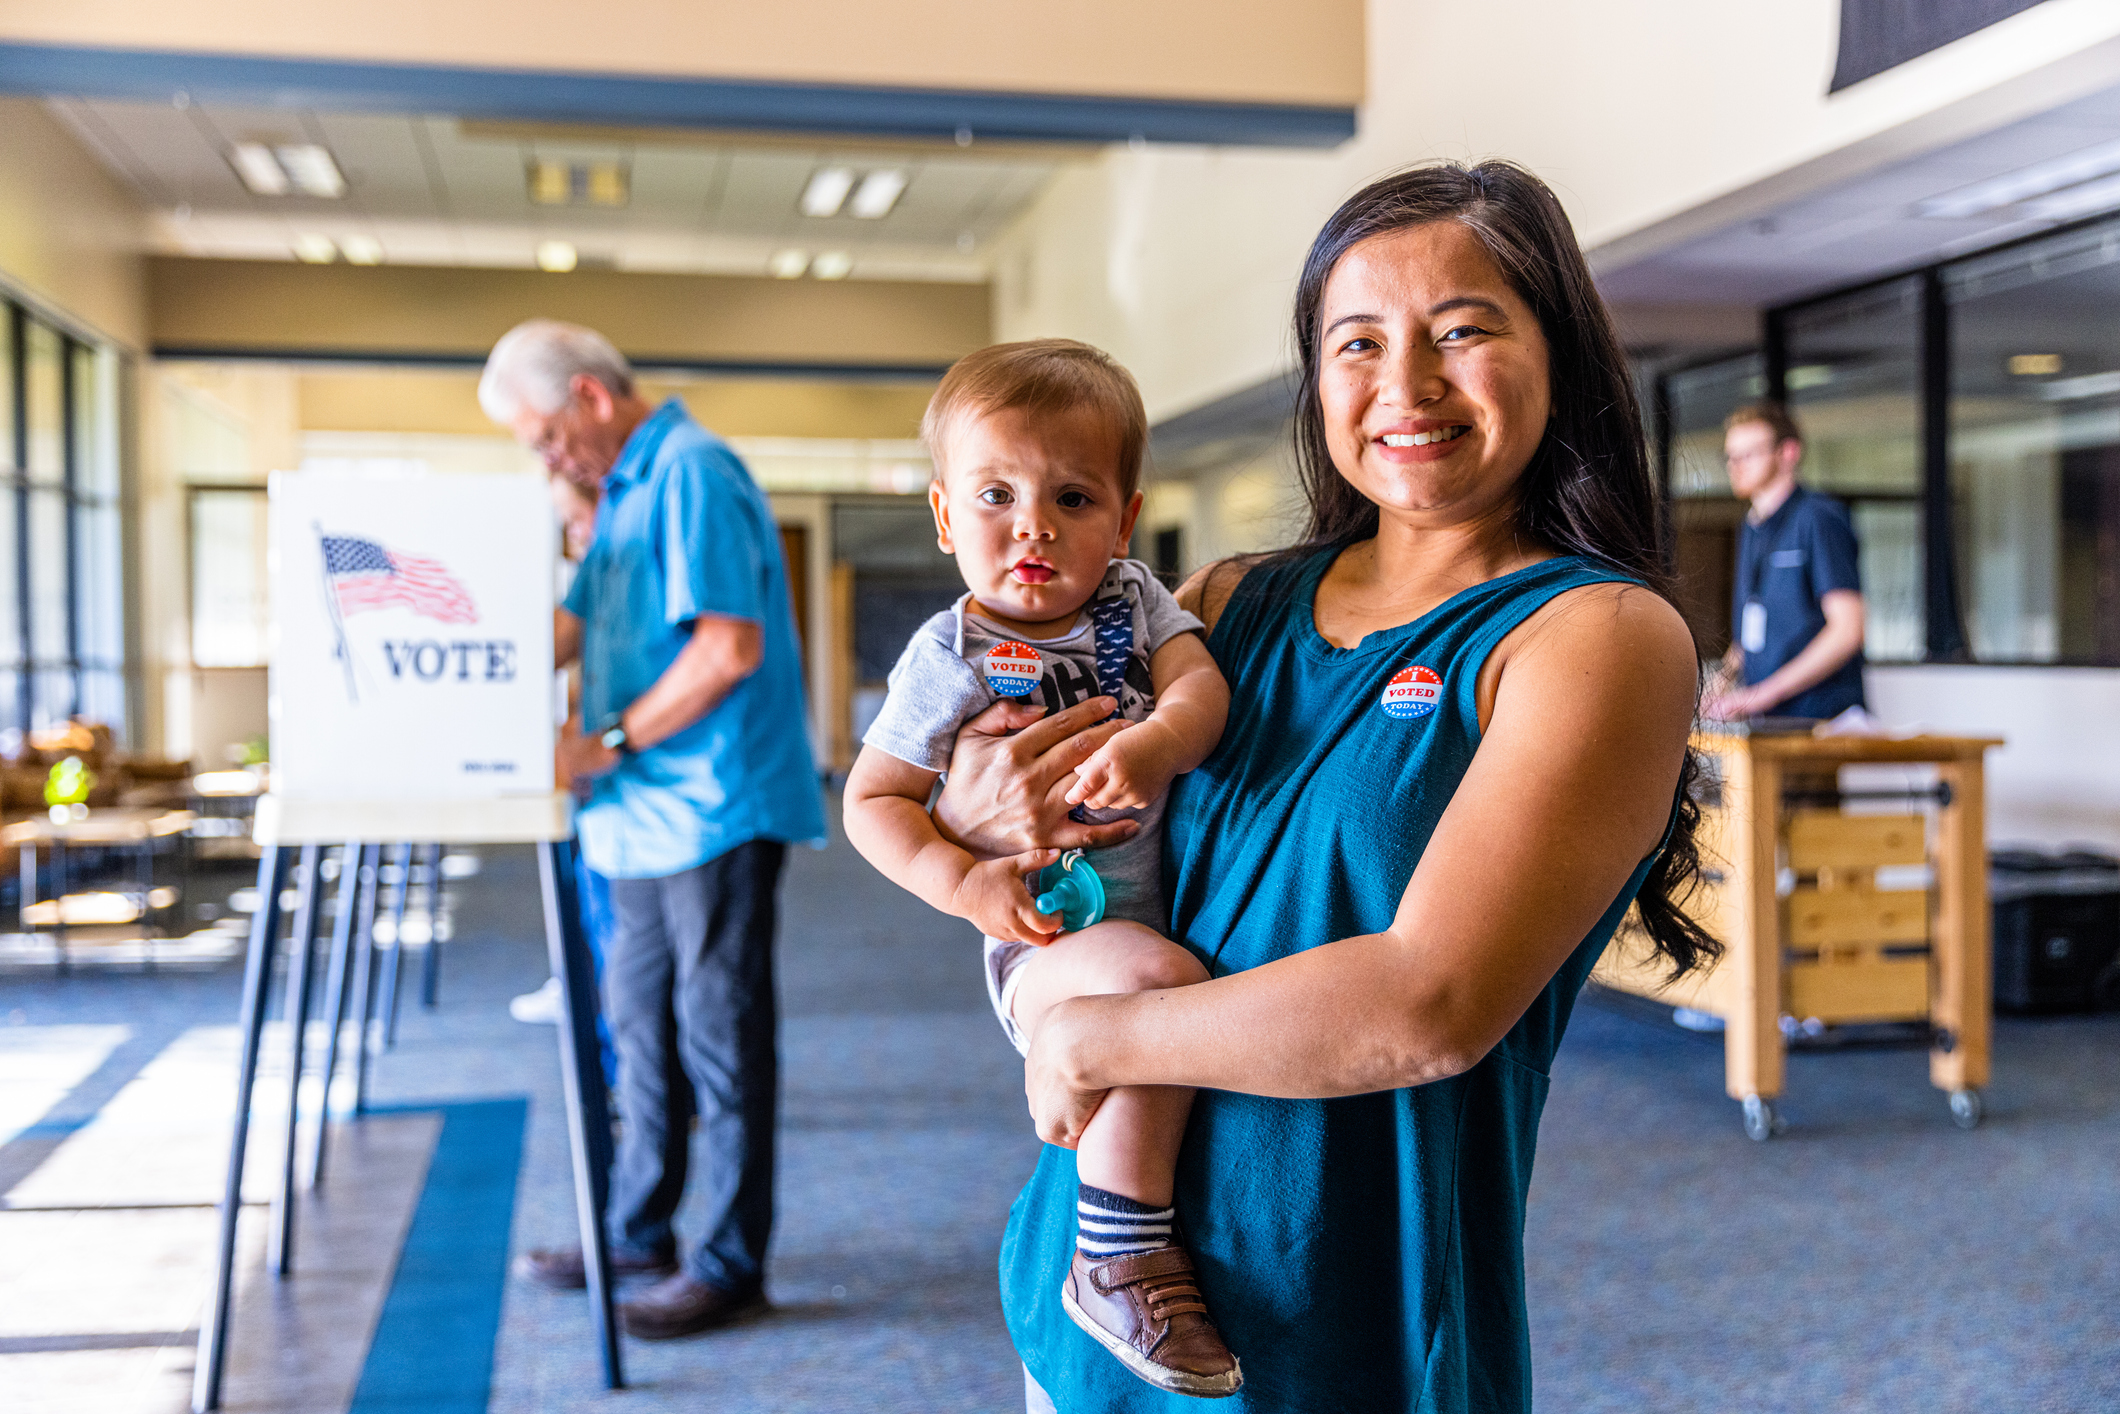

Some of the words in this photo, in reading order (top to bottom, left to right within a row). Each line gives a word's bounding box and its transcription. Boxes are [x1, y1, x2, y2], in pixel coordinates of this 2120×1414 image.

[1010, 646, 1017, 657] I
[382, 639, 516, 681] VOTE
[990, 662, 1037, 674] VOTED
[1410, 671, 1419, 681] I
[996, 678, 1029, 687] TODAY
[1389, 687, 1435, 698] VOTED
[1390, 702, 1424, 710] TODAY
